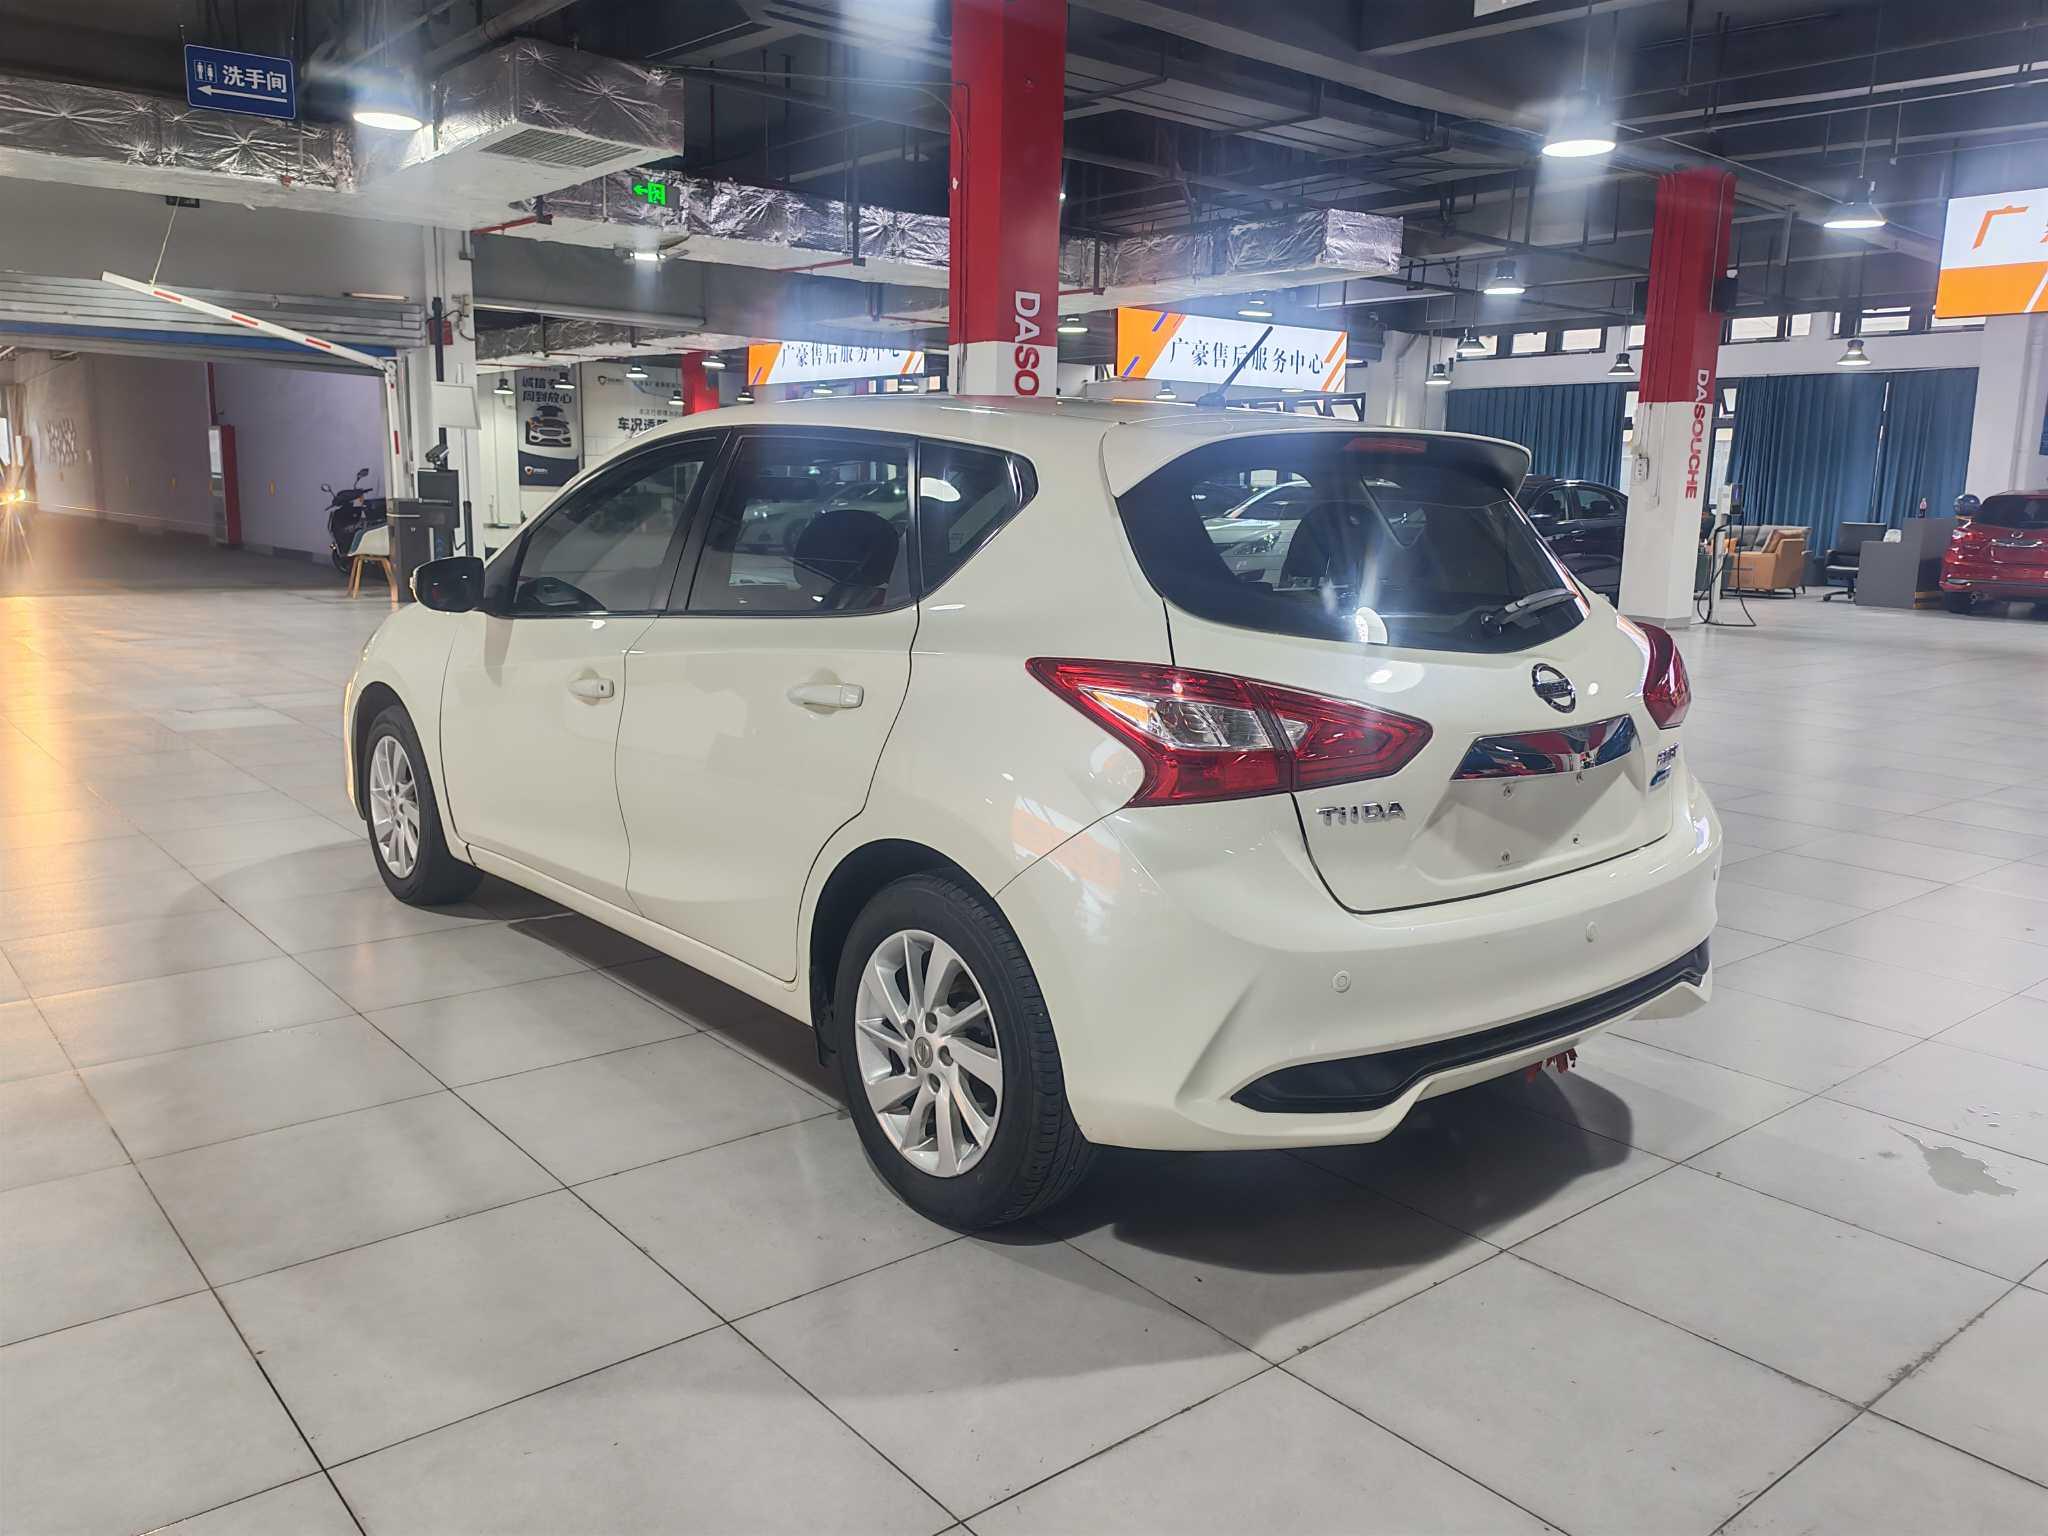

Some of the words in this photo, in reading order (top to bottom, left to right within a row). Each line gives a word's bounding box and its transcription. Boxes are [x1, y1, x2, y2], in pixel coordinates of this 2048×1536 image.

[222, 64, 287, 93] 洗手间
[1170, 337, 1324, 375] 广豪售后服务中心
[1685, 369, 1709, 499] DASOUCHE
